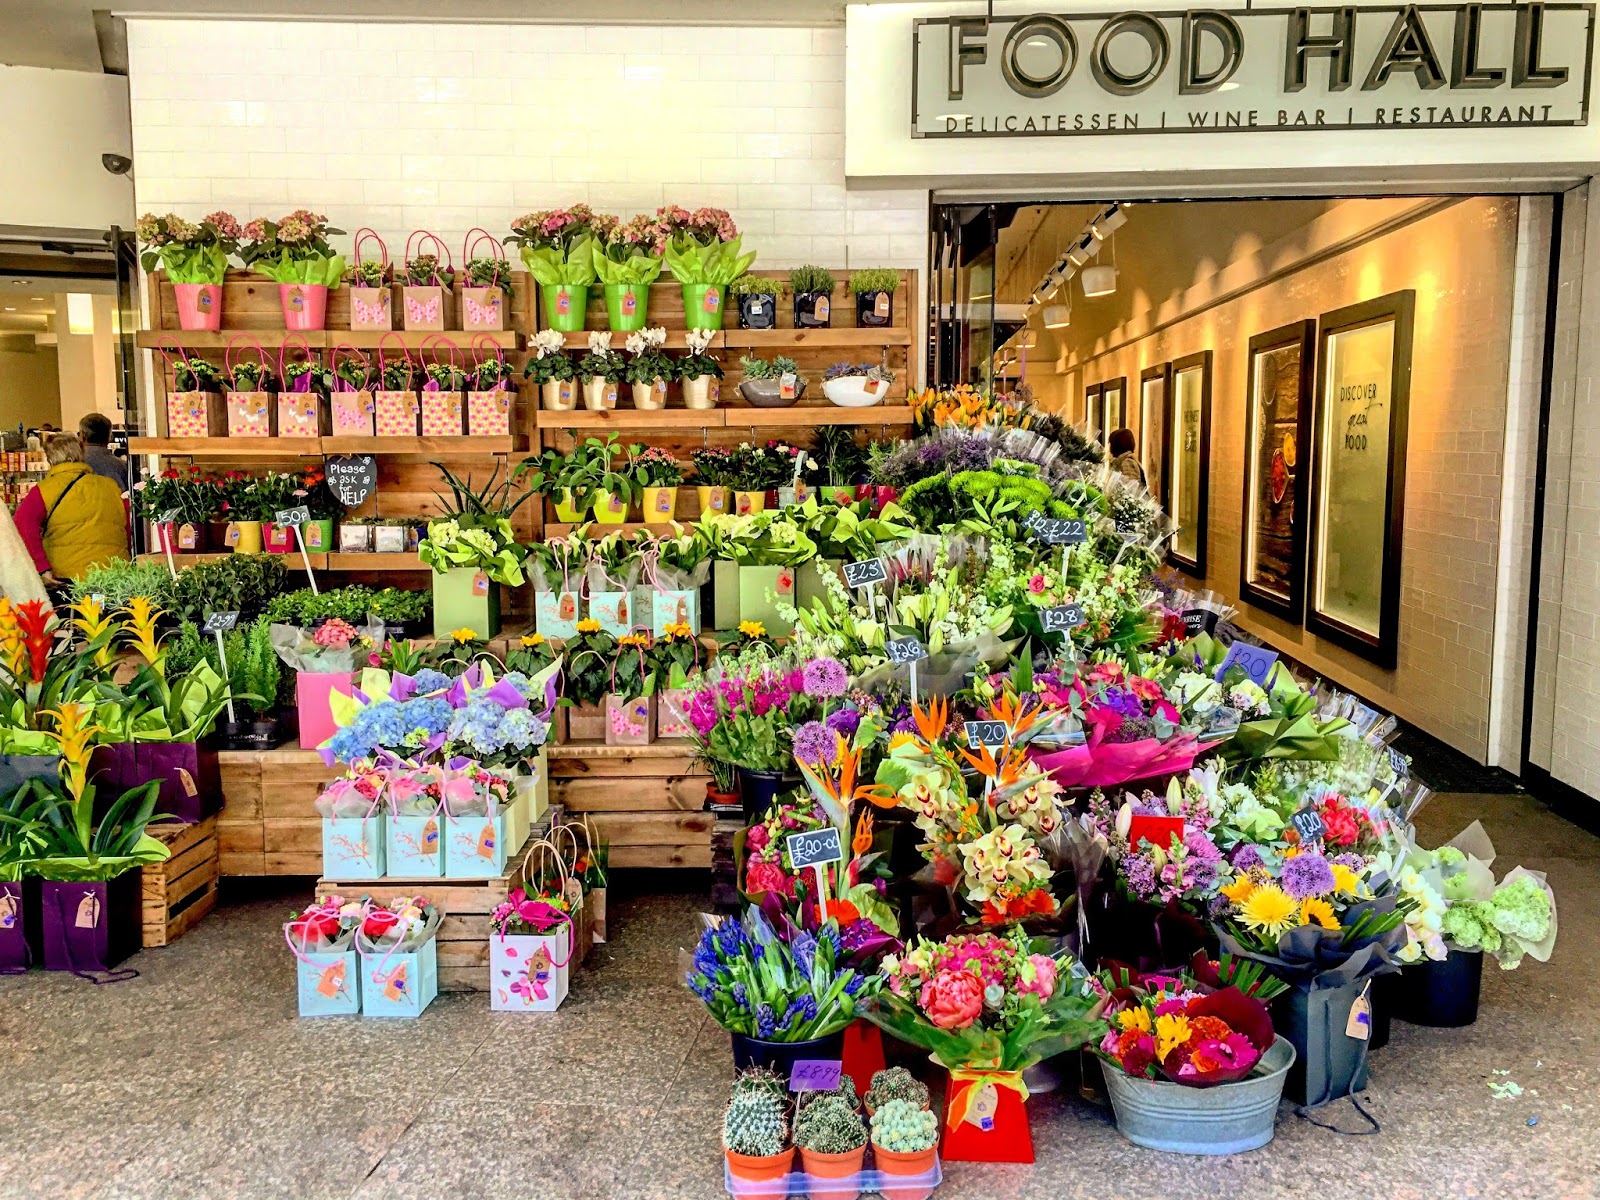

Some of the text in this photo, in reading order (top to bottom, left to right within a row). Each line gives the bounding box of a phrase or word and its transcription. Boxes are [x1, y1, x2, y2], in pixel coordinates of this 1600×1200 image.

[948, 2, 1569, 101] FOOD HALL
[946, 105, 1552, 132] DELICATESSEN WINE BAR RESTAURANT
[1340, 383, 1377, 401] DISCOVER
[1345, 433, 1367, 450] FOOD
[330, 464, 366, 474] Please
[339, 475, 358, 484] ask
[339, 484, 352, 492] for
[340, 489, 367, 505] HELP
[847, 561, 879, 582] £25
[1045, 609, 1078, 629] £28
[890, 640, 920, 663] £26
[969, 722, 1006, 746] £20
